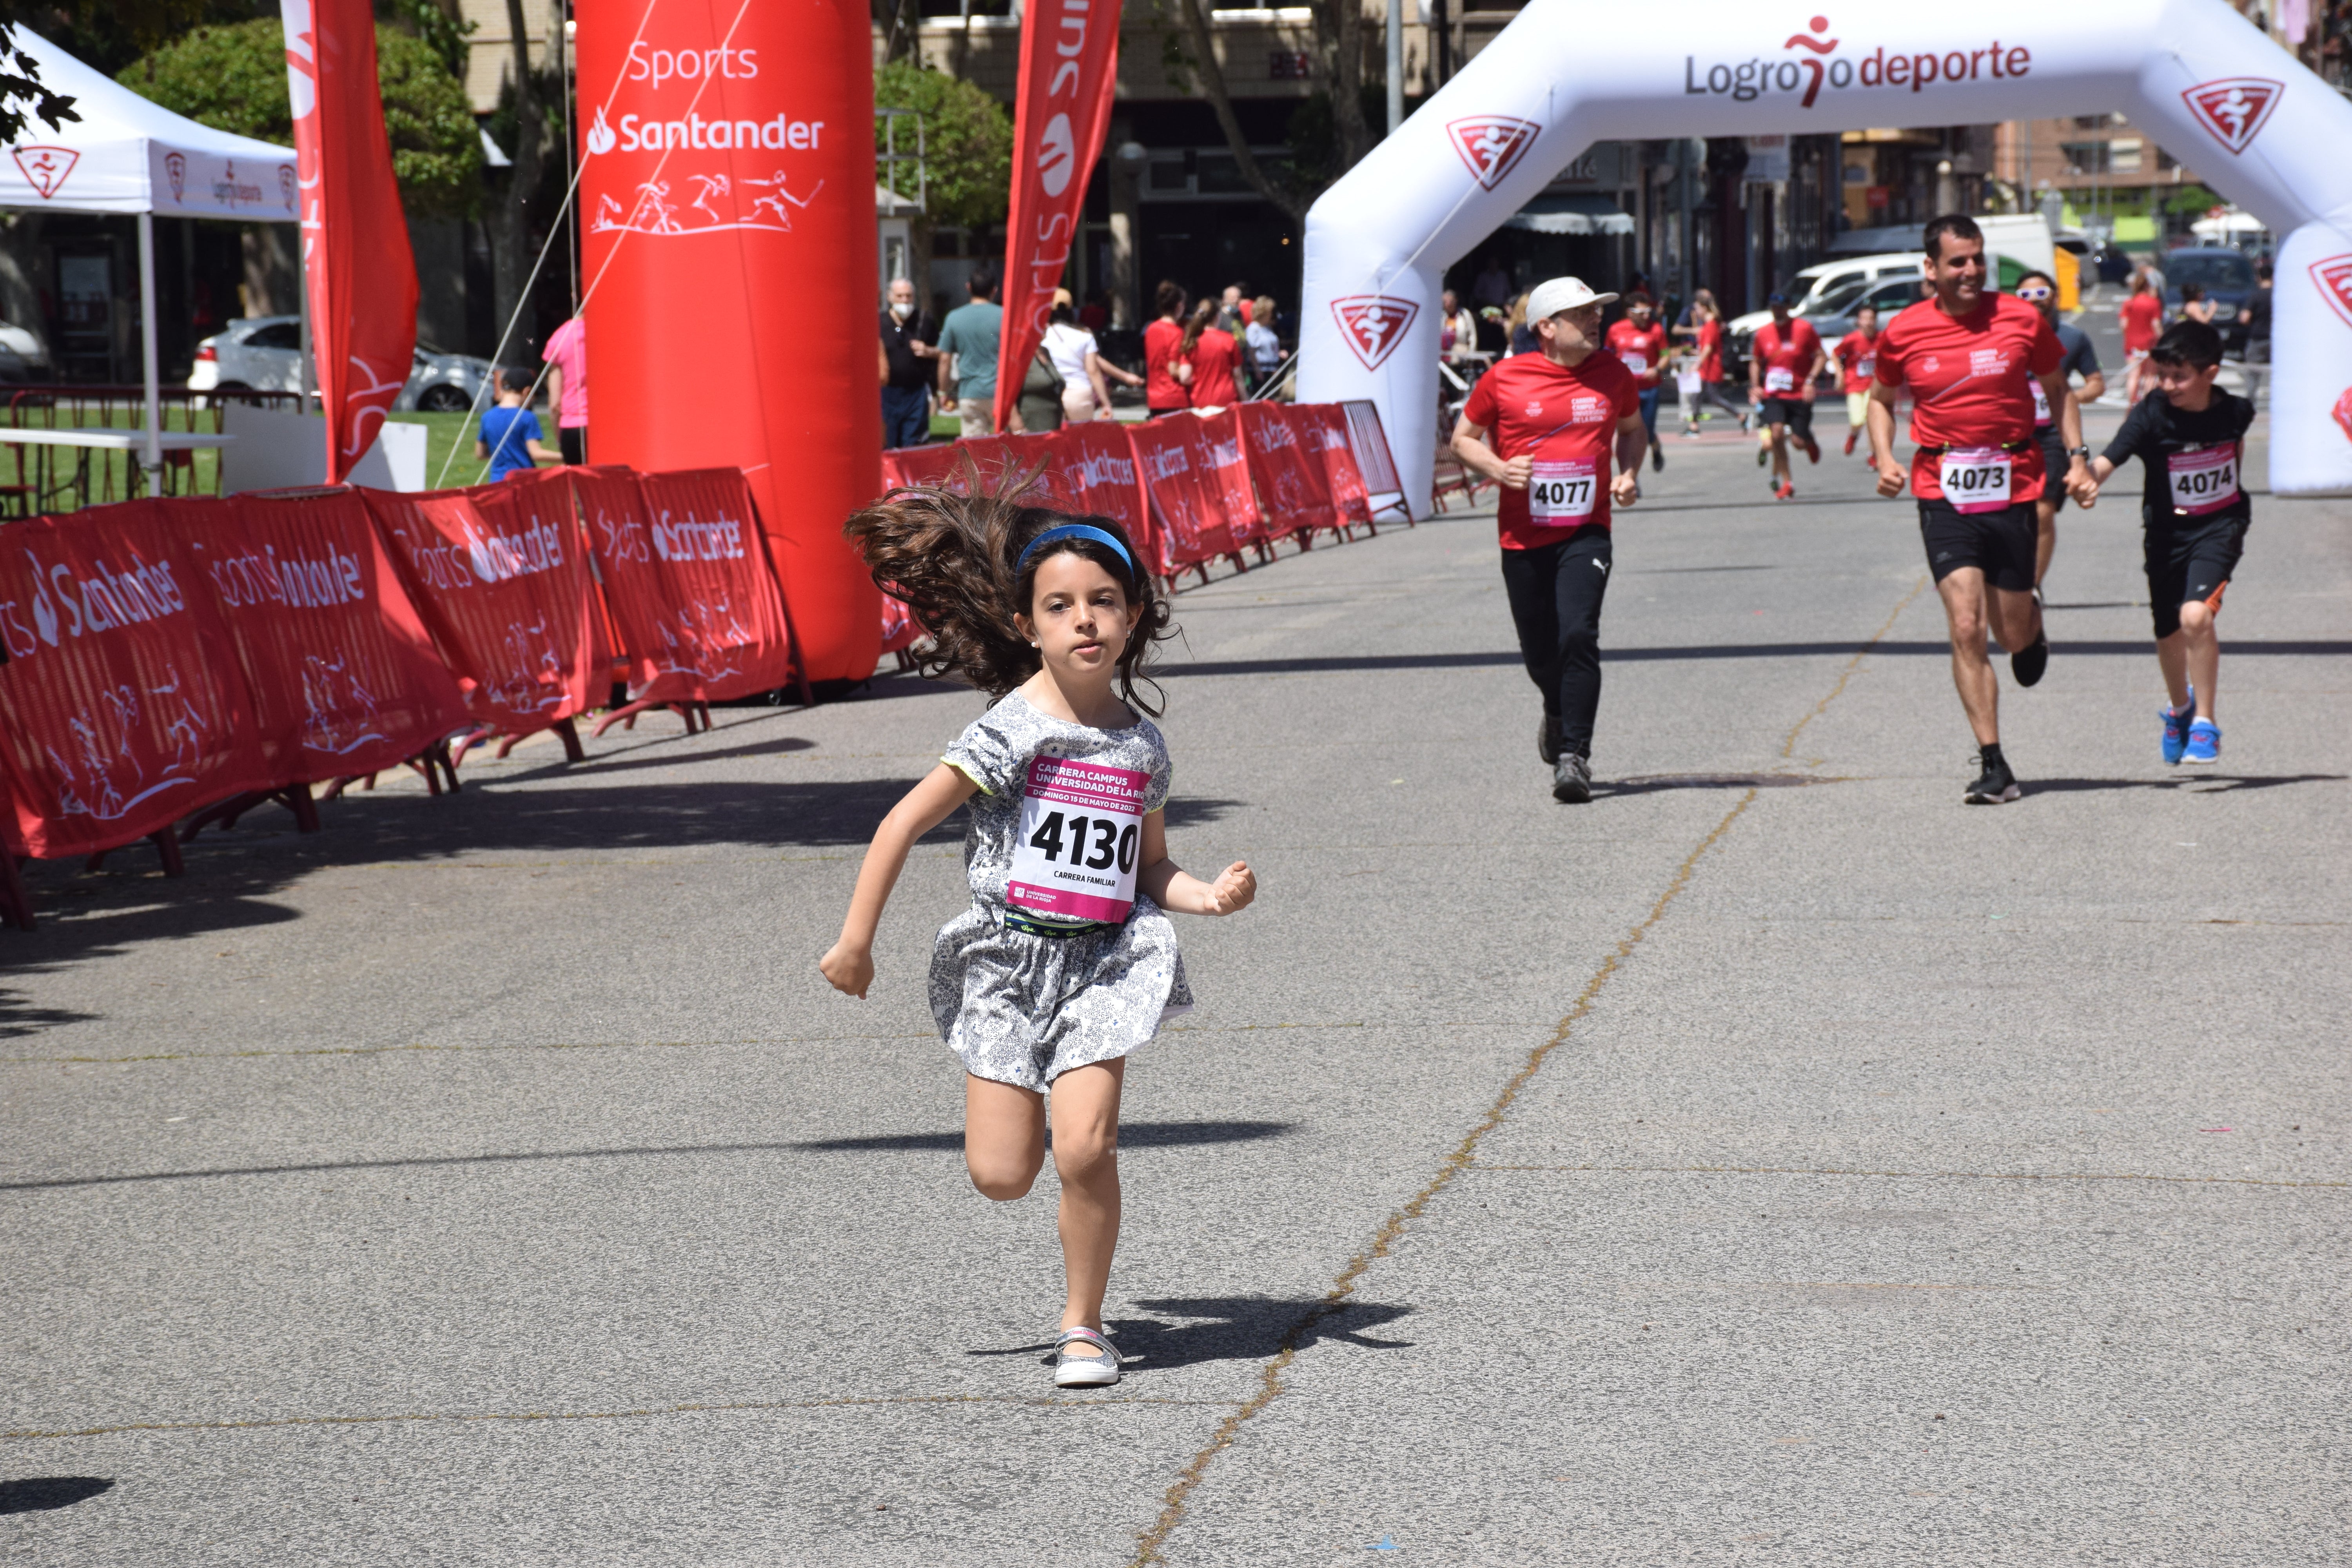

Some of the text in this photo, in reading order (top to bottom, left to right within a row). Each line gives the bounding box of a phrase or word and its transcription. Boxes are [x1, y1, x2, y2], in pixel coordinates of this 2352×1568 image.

[629, 41, 759, 90] Sports
[620, 112, 824, 152] Santander
[1947, 466, 2004, 490] 4073
[2177, 465, 2233, 495] 4074
[1535, 480, 1590, 505] 4077
[51, 553, 184, 637] Santander
[1036, 773, 1105, 792] UNIVERSIDAD
[1106, 786, 1119, 795] DE
[1120, 788, 1132, 797] LA
[1038, 764, 1128, 786] CARRERA CAMPUS
[1033, 789, 1070, 800] DOMINGO
[1089, 799, 1109, 808] MAYO
[1120, 804, 1135, 812] 2022
[1030, 811, 1138, 875] 4130
[1053, 870, 1116, 887] CARRERA FAMILIAR
[1027, 890, 1056, 900] UNIVERSIDAD
